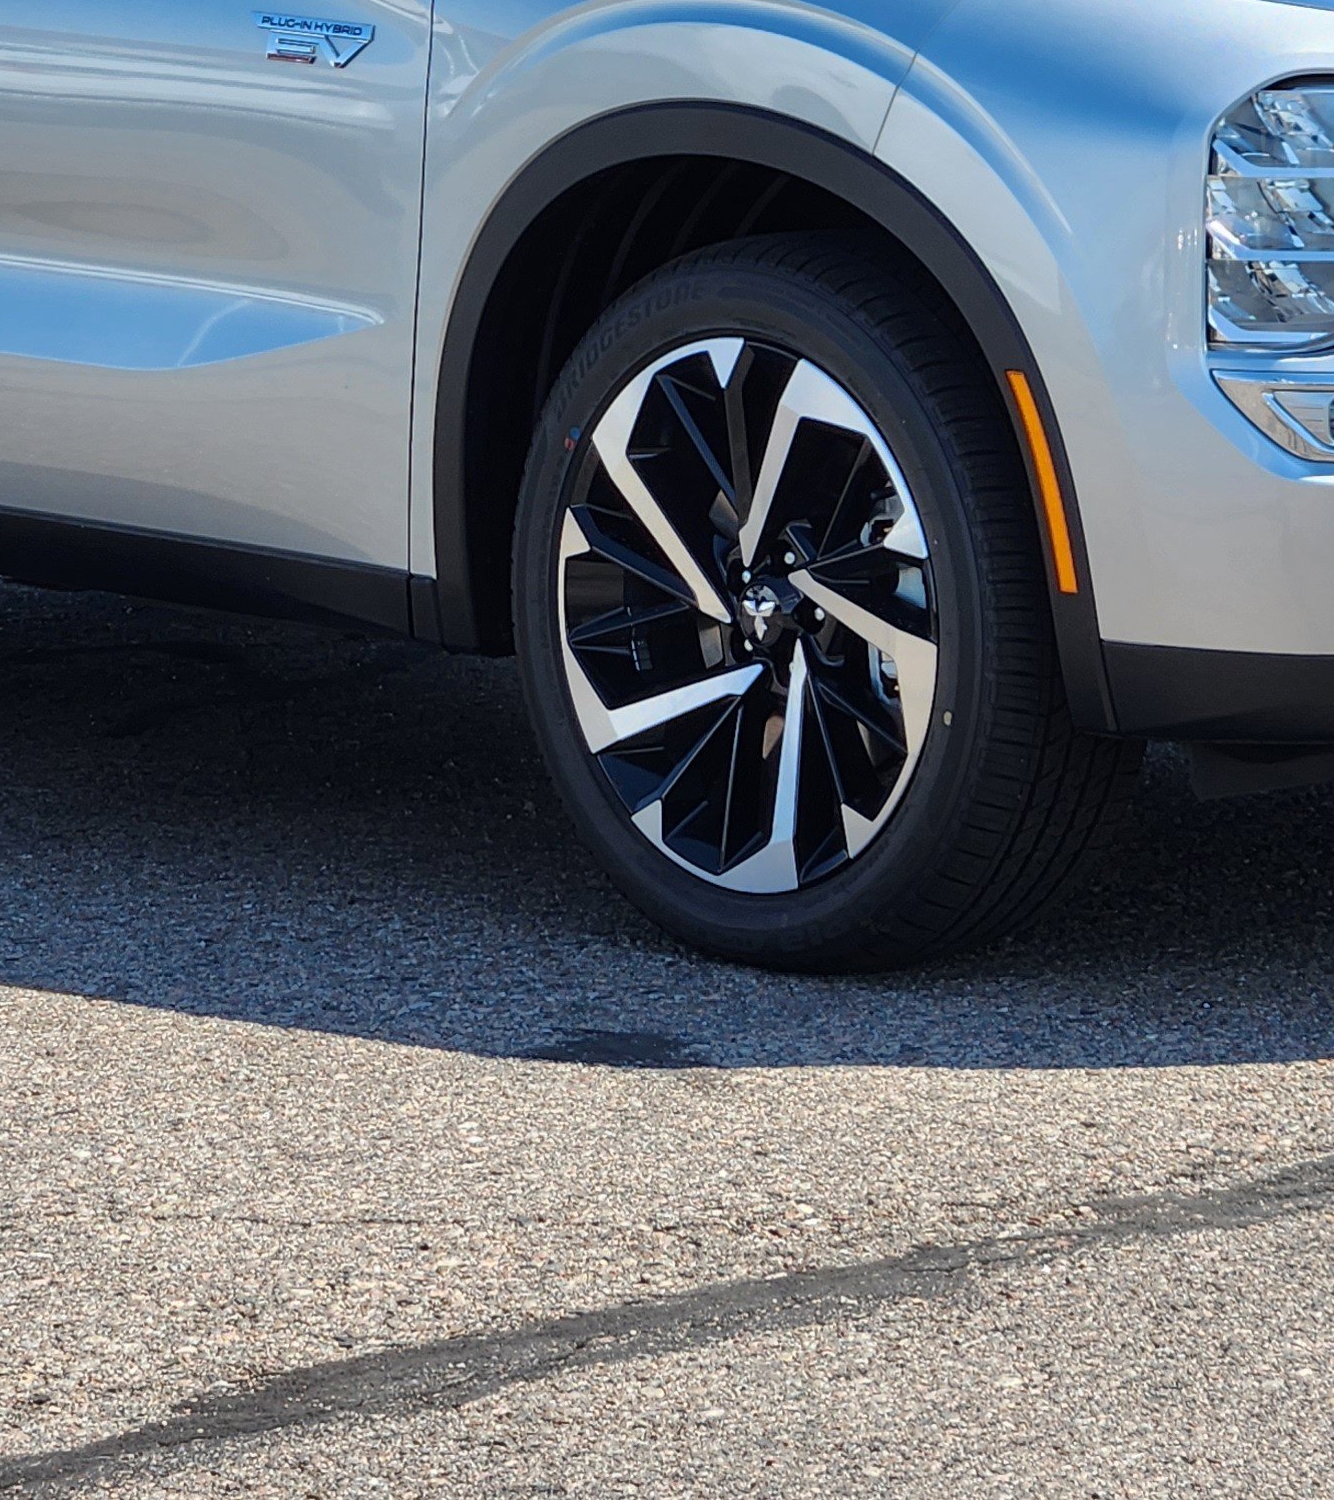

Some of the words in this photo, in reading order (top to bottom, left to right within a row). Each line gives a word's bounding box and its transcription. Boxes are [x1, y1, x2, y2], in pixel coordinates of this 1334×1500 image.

[261, 15, 312, 31] PLUG-IN
[313, 21, 363, 37] HYBRID
[265, 31, 375, 69] EV
